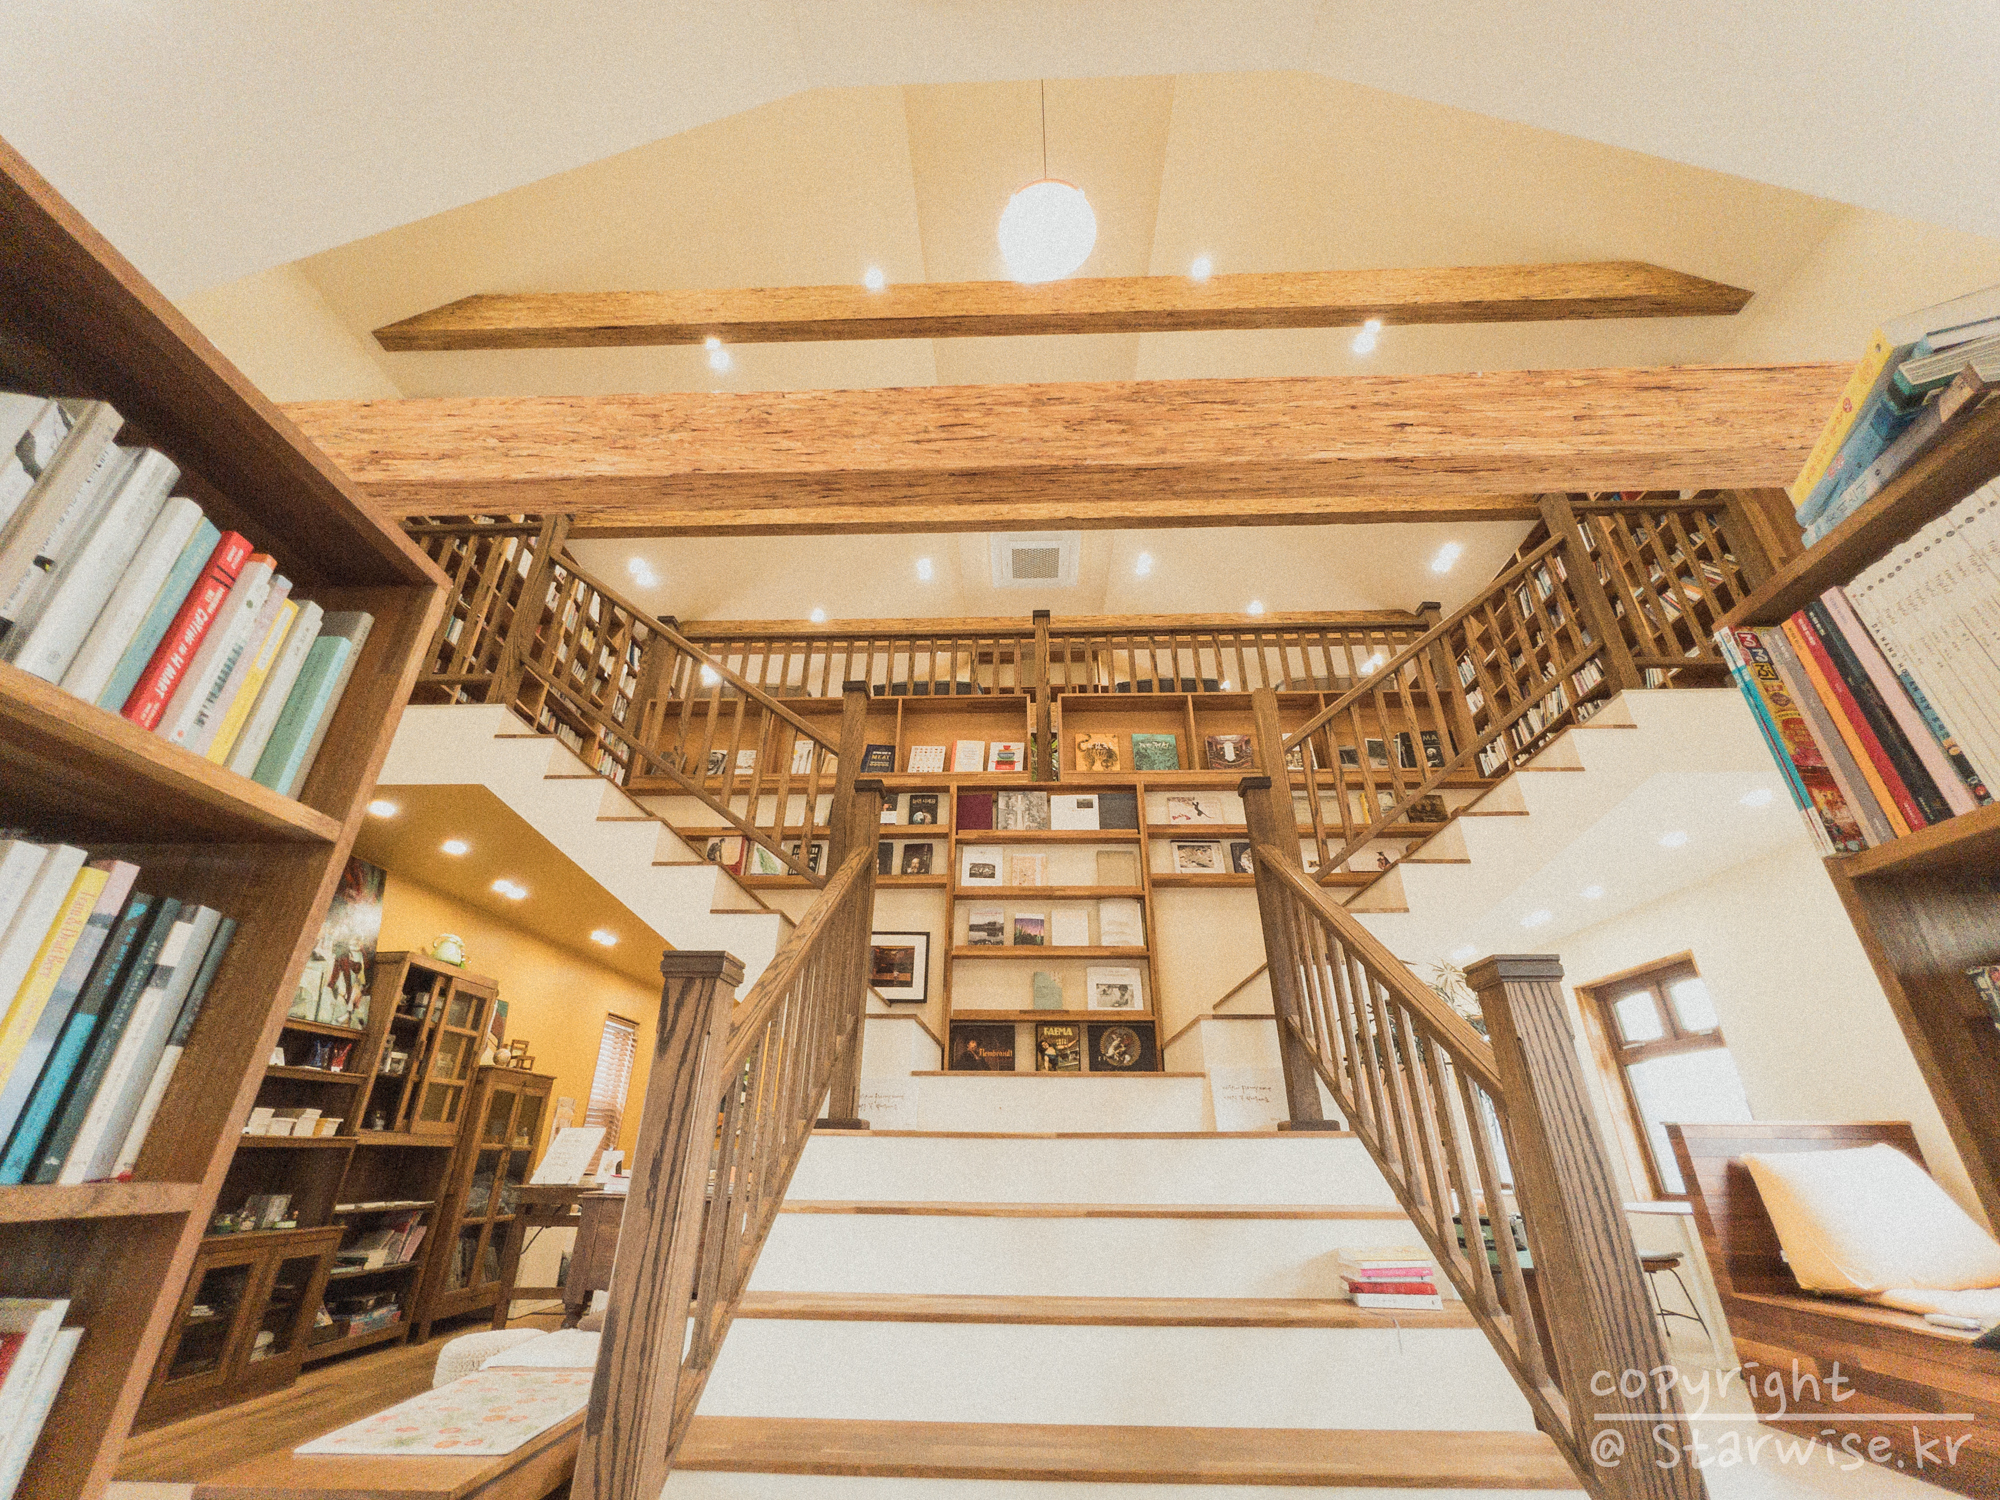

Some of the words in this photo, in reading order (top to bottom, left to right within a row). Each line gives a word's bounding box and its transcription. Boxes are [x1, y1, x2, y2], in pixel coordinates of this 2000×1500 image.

[184, 608, 208, 645] CRYING
[1880, 636, 1898, 659] NANG
[155, 662, 177, 699] MART
[1043, 1027, 1073, 1036] FAEMA
[979, 1048, 1013, 1057] Rembrandt
